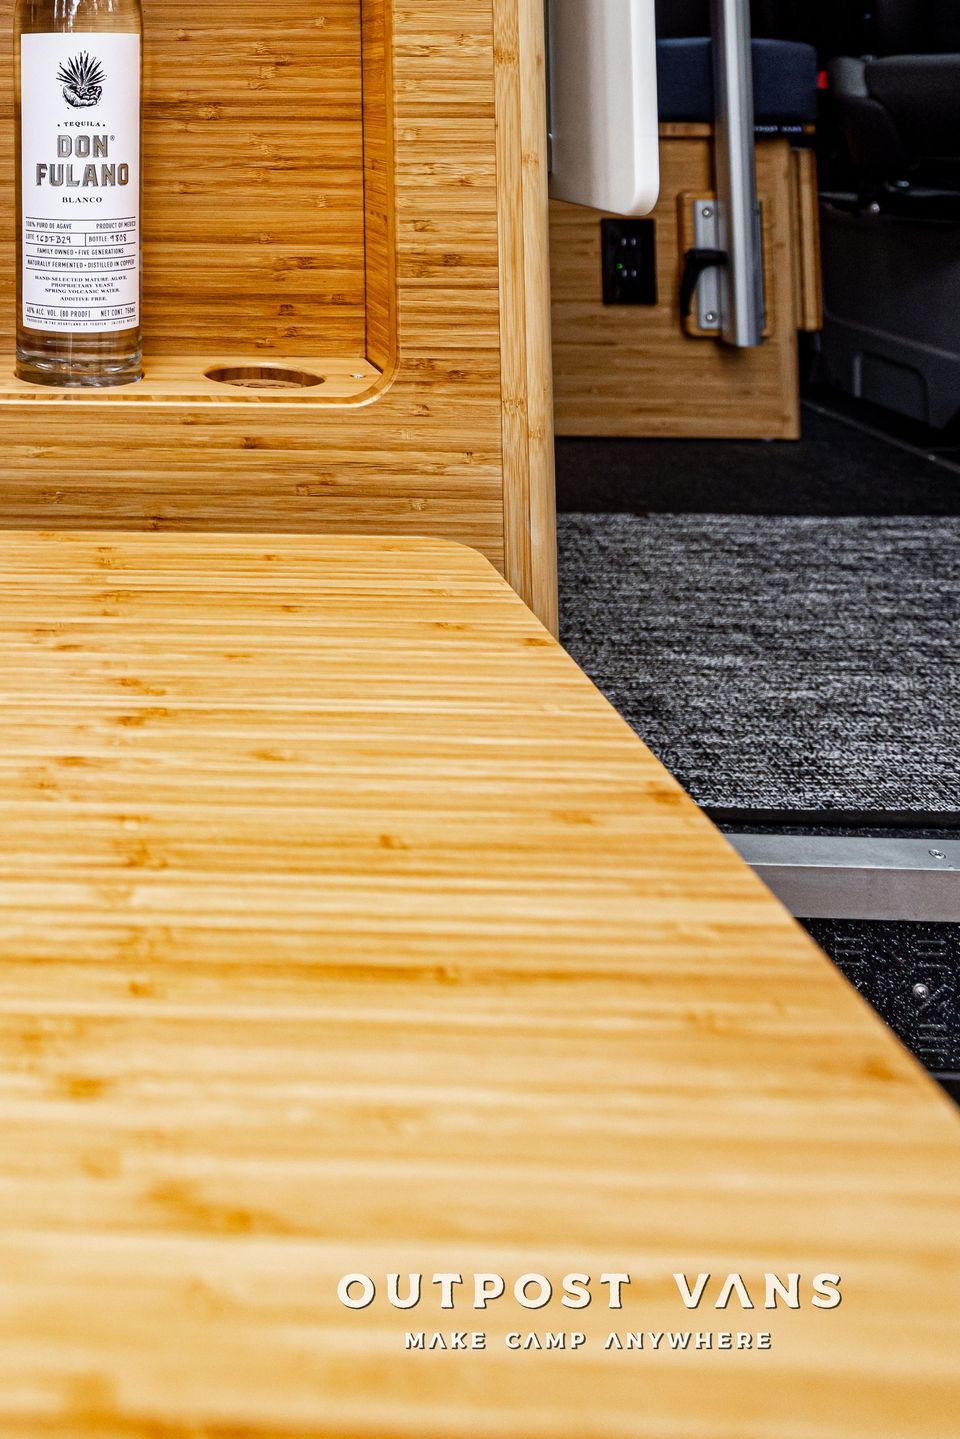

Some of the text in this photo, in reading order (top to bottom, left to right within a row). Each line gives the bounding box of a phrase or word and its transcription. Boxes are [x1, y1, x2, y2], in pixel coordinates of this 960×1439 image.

[57, 135, 108, 158] DON
[36, 163, 129, 187] FULANO
[88, 260, 113, 268] DISTILLED
